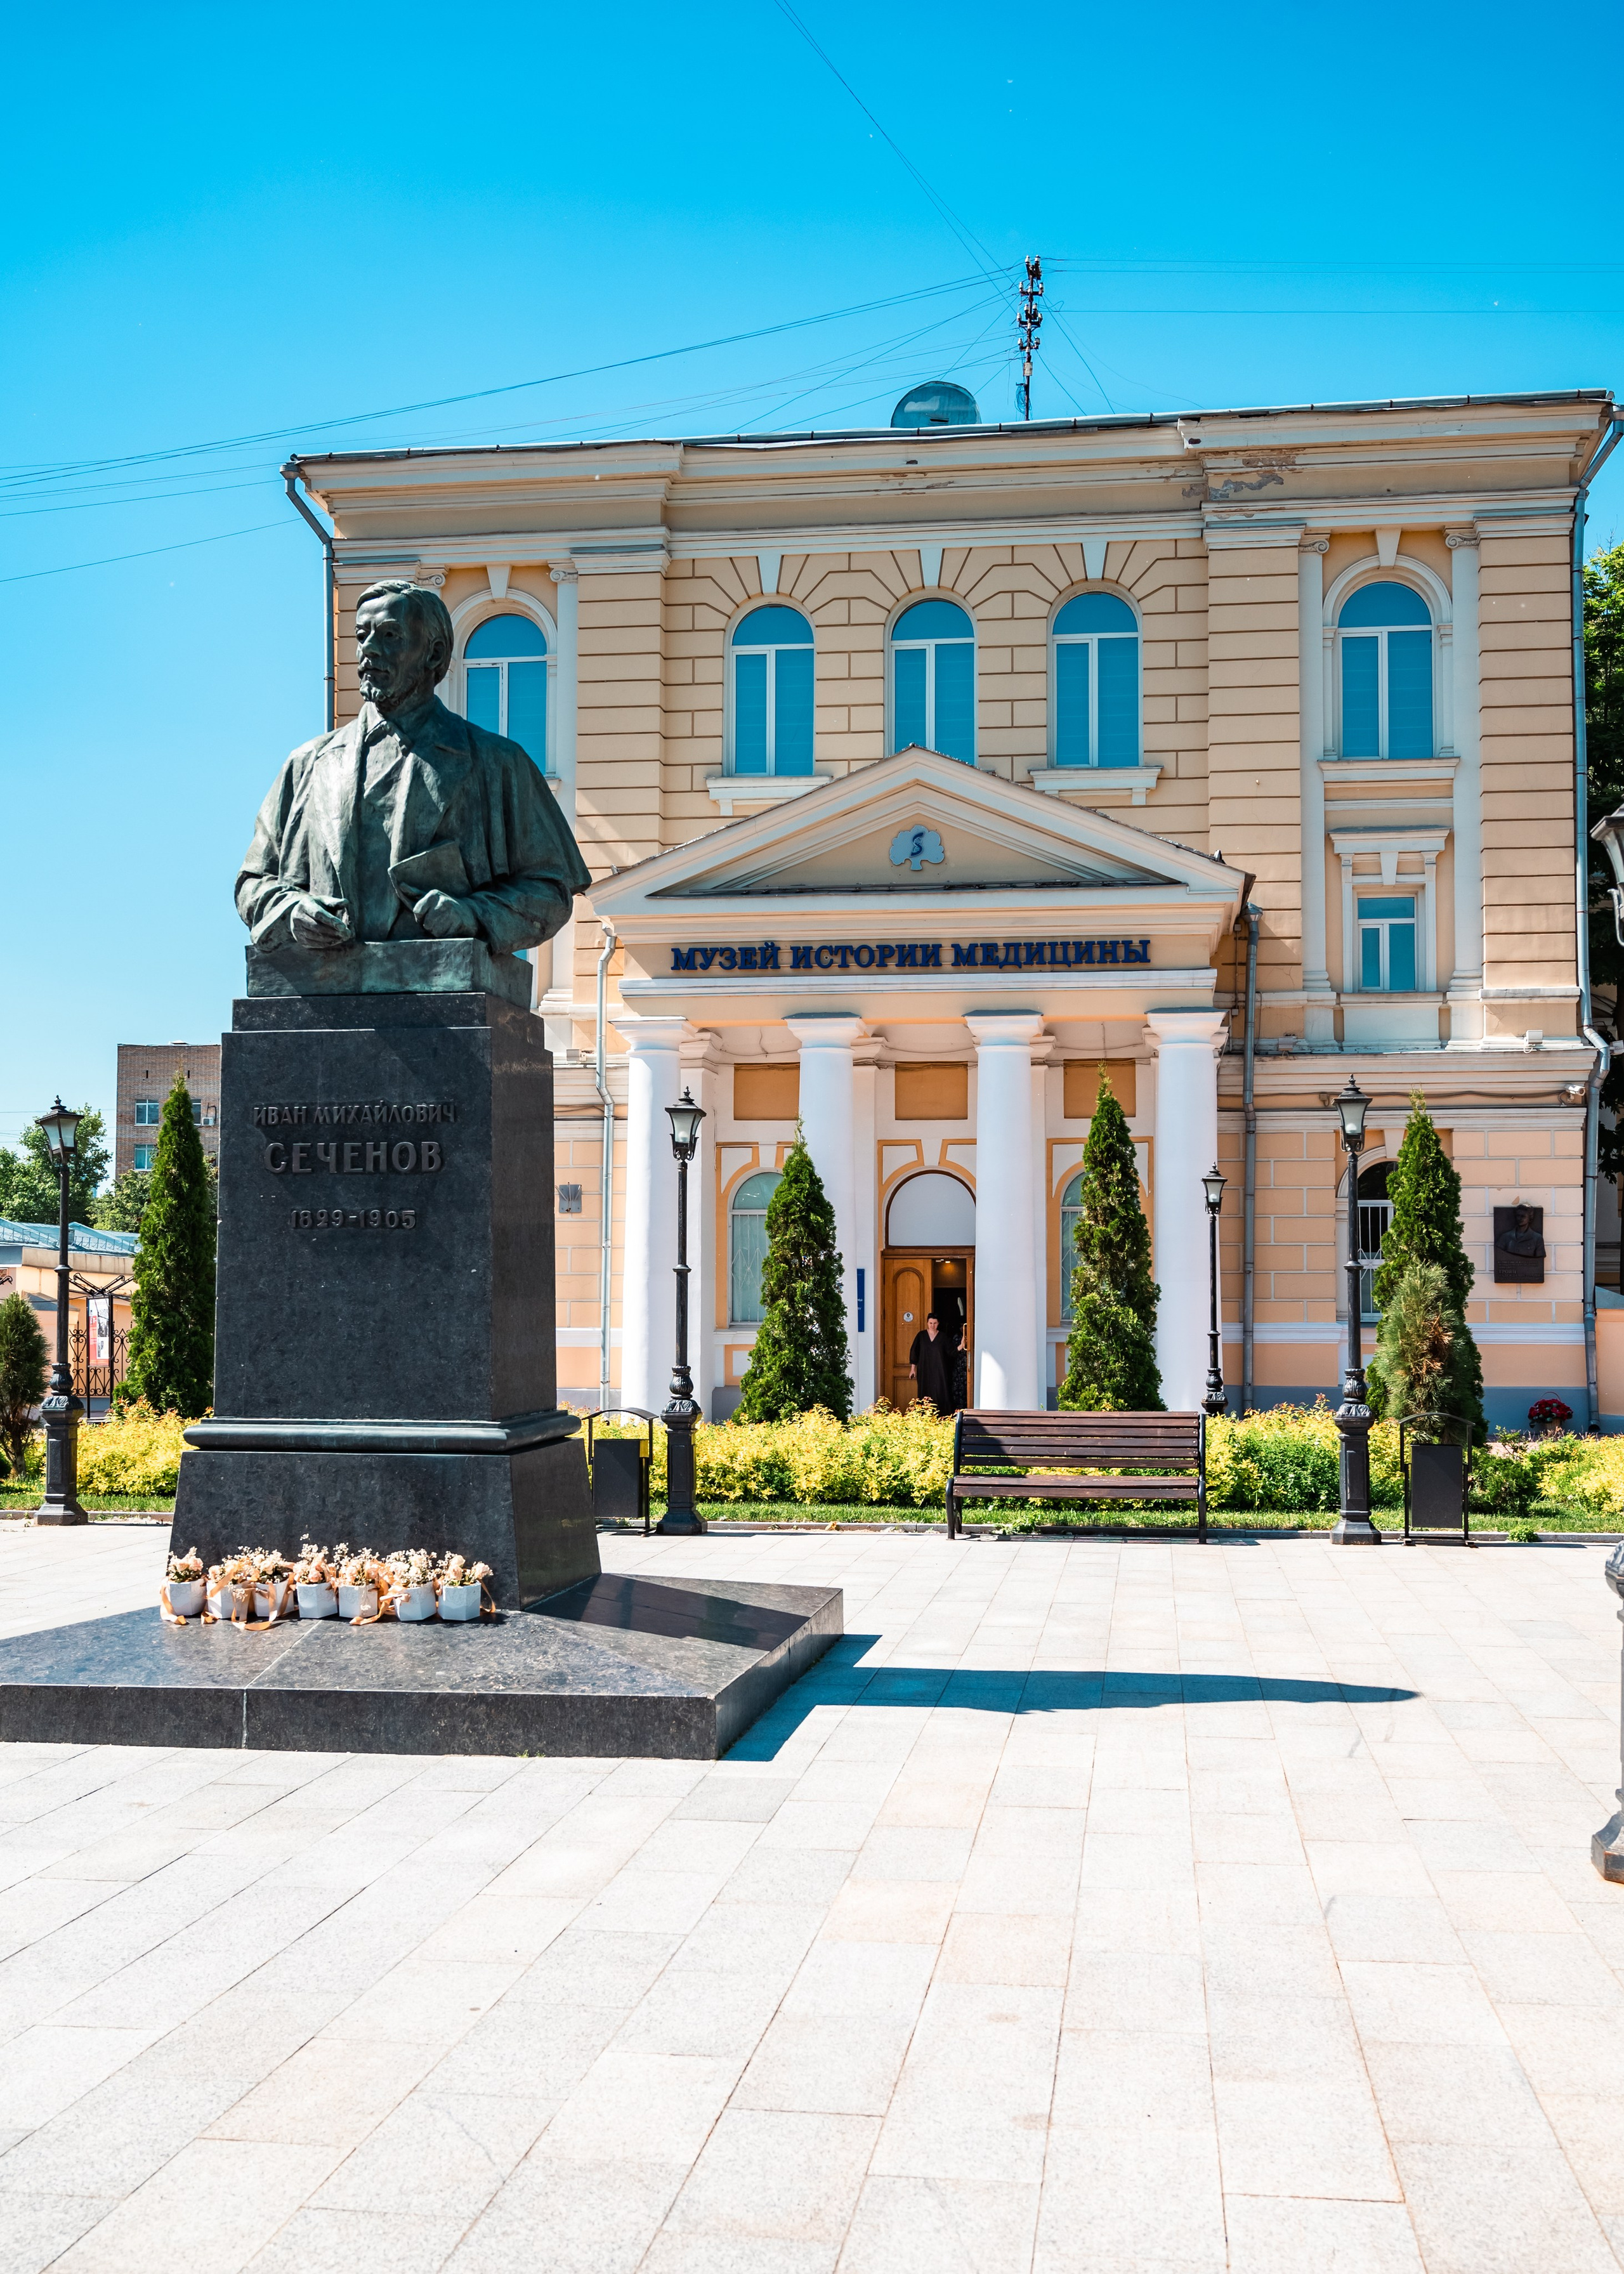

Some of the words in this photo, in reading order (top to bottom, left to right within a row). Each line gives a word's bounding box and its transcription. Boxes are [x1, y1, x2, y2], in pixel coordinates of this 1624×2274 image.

[671, 941, 781, 970] МУЗЕЙ
[790, 943, 943, 969] ИСТОРИИ
[951, 939, 1151, 969] МЕДИЦИНЫ
[254, 1106, 307, 1126] ИВАН
[313, 1101, 455, 1125] МИХАЙЛОВИЧ
[264, 1142, 442, 1173] СЕЧЕНОВ
[289, 1209, 416, 1229] 1829-1905
